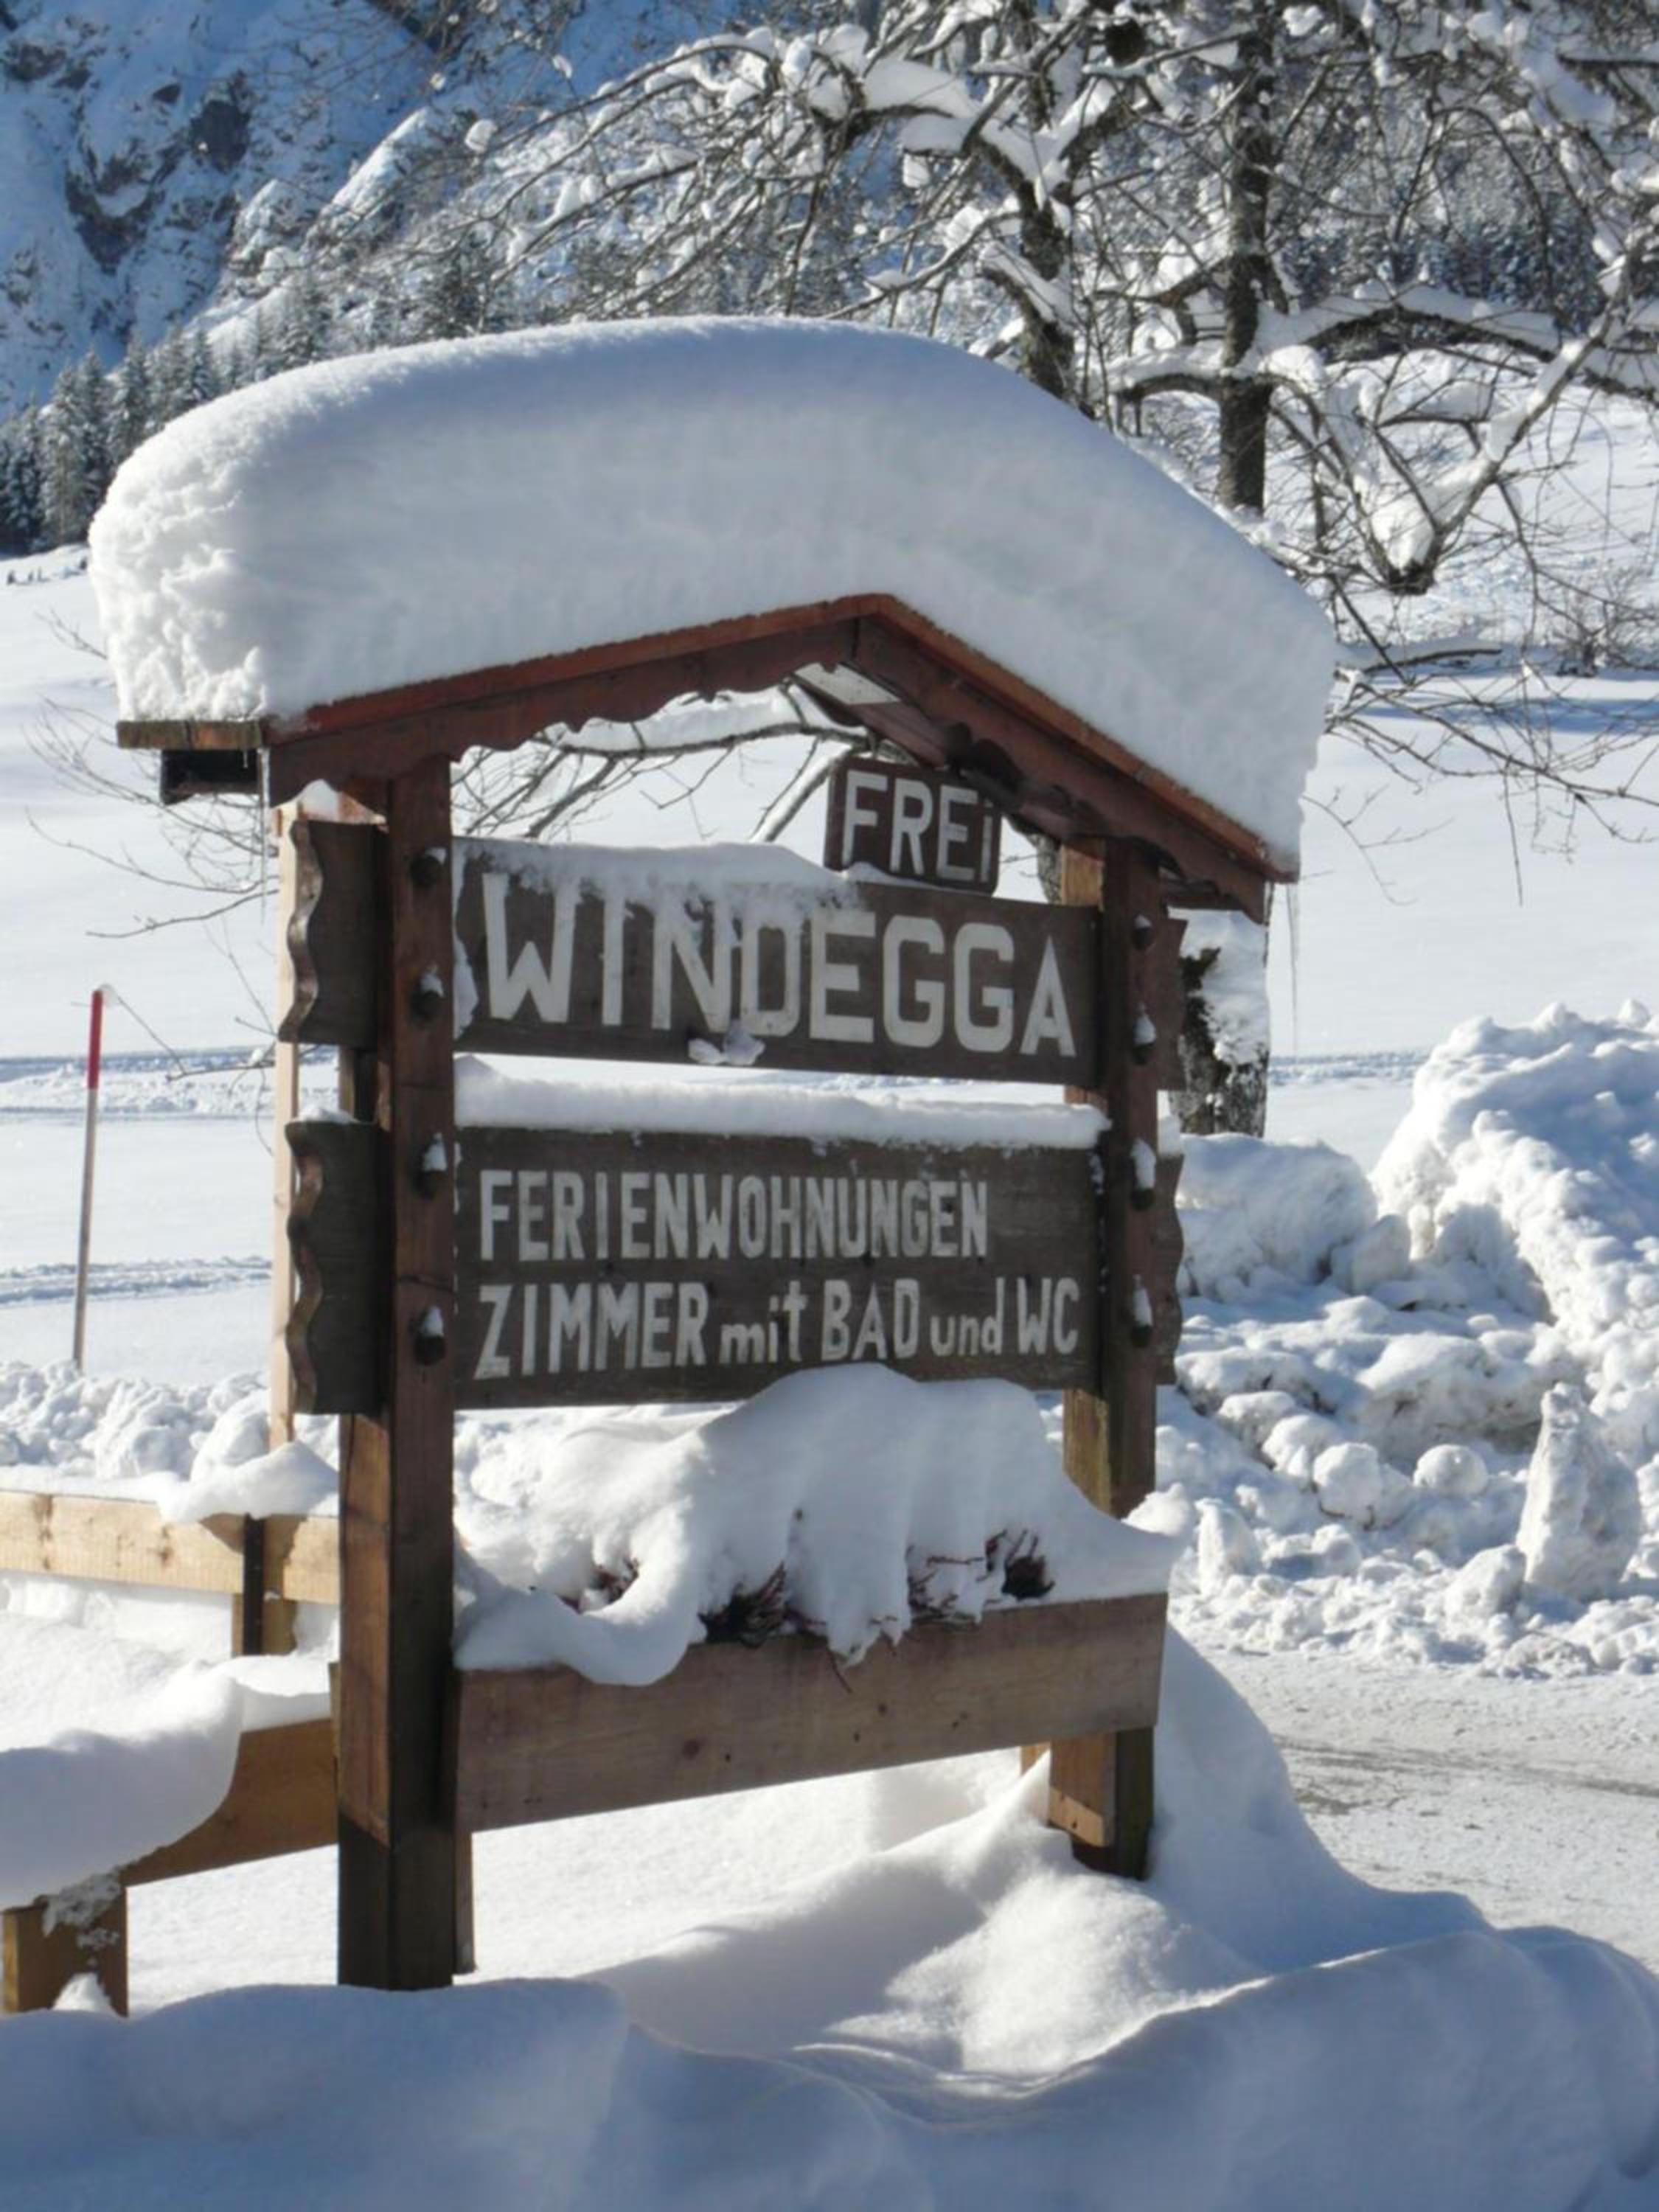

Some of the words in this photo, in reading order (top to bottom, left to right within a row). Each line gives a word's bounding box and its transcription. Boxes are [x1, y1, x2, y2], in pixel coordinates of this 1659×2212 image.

[483, 873, 1076, 1057] WINDEGGA
[480, 1170, 988, 1262] FERIENWOHNUNGEN
[474, 1282, 709, 1380] ZIMMER
[719, 1280, 808, 1364] mit
[821, 1279, 920, 1361] BAD
[931, 1277, 1004, 1357] und
[1017, 1277, 1079, 1355] WC
